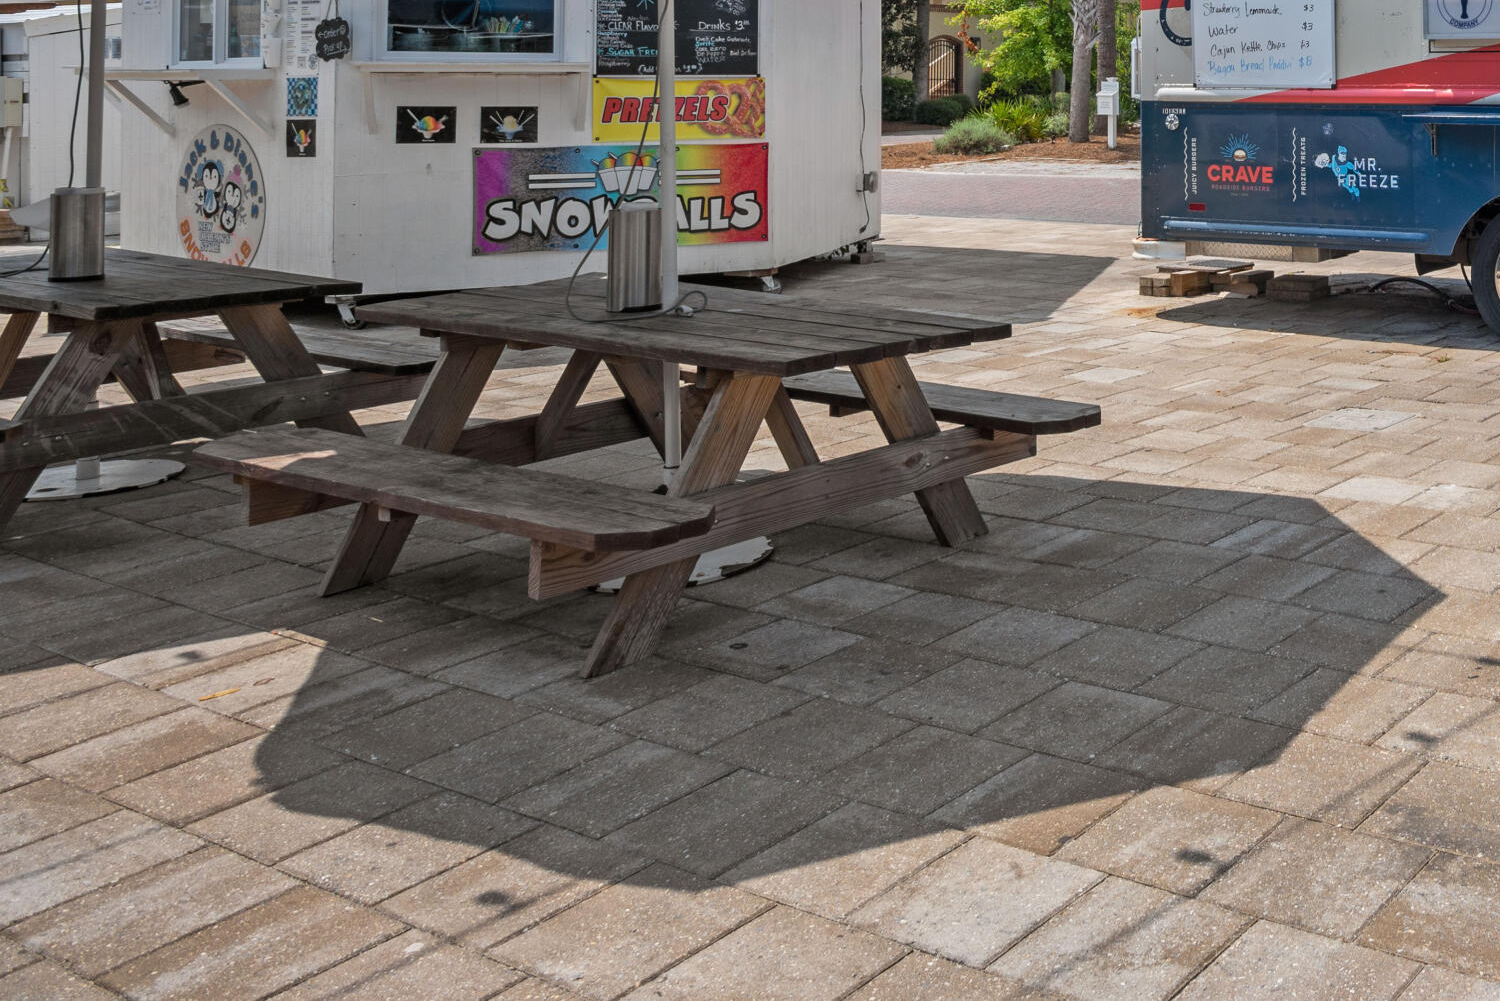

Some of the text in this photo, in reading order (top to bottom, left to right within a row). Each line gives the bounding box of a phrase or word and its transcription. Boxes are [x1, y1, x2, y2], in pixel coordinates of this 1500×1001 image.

[1303, 4, 1314, 12] $3
[636, 20, 659, 31] Flavo
[1208, 21, 1314, 38] Water $3
[1451, 18, 1479, 29] COMPANY
[1210, 44, 1235, 59] Cajun
[1353, 157, 1382, 171] MR.
[179, 137, 207, 194] Jack
[223, 131, 264, 220] Diane's
[1207, 164, 1274, 184] CRAVE
[1337, 174, 1399, 189] FREEZE
[481, 189, 763, 243] SNOWLLS
[180, 218, 252, 266] SNOLS
